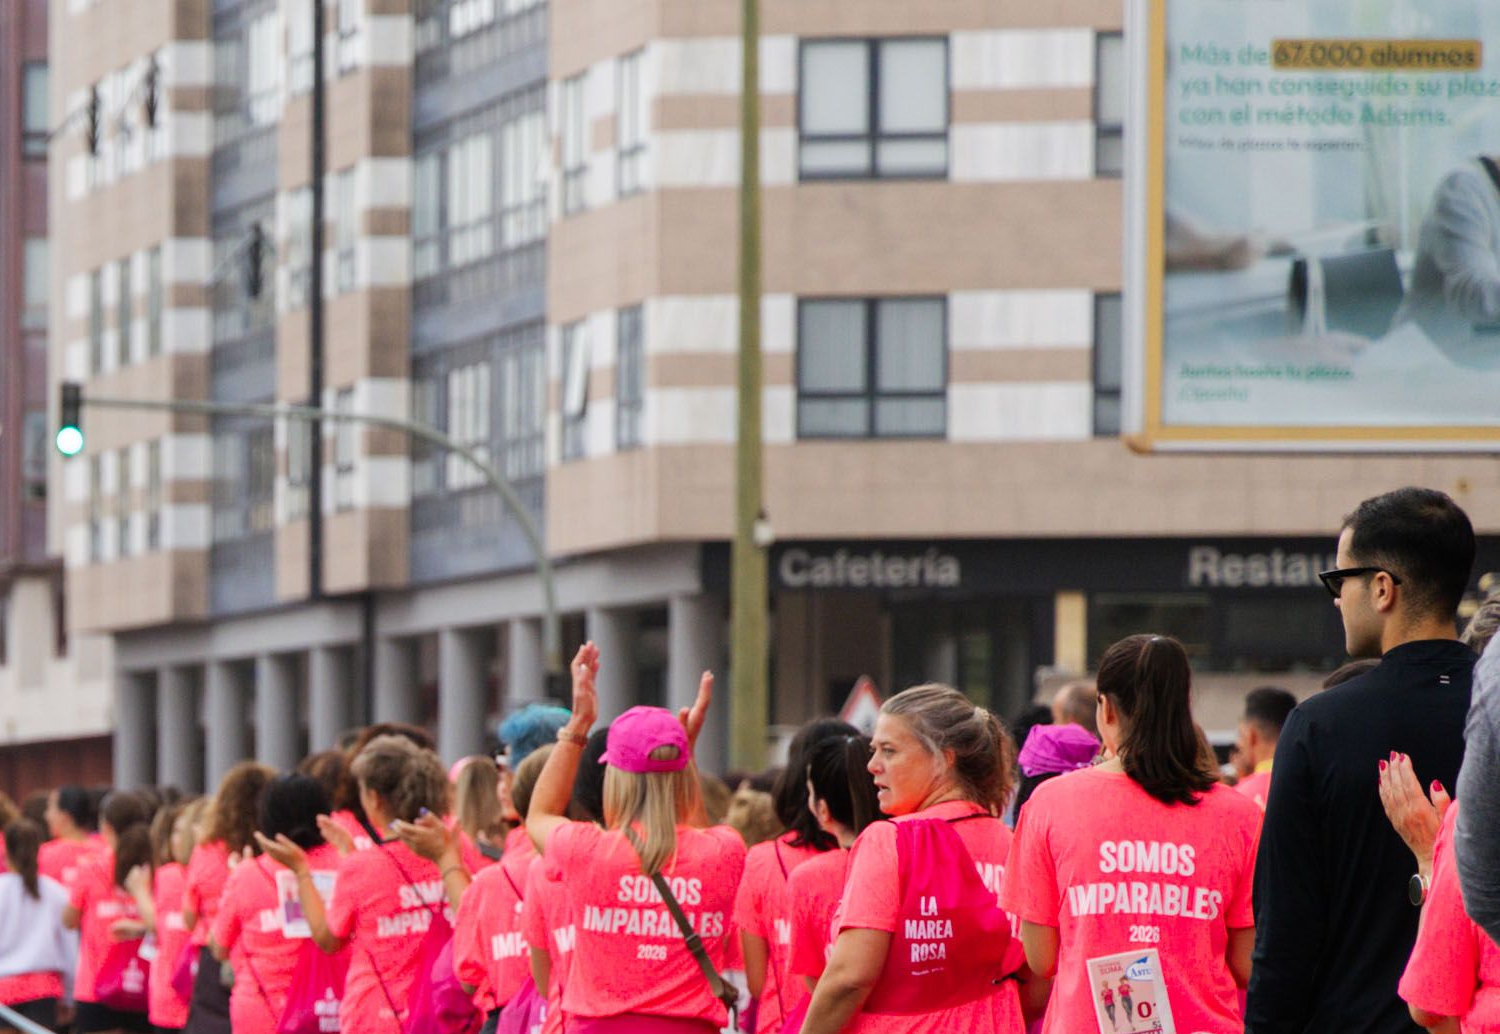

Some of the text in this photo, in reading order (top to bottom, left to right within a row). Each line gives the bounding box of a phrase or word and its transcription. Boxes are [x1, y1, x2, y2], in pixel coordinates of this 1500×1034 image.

[1180, 41, 1475, 66] Más de 67.000 alumnos
[1179, 72, 1500, 101] ya han conseguido su plaz
[1178, 107, 1224, 125] con
[1229, 102, 1249, 126] el
[1256, 102, 1354, 126] método
[779, 547, 961, 587] Cafetería
[1099, 840, 1196, 876] SOMOS
[920, 896, 938, 916] LA
[1068, 881, 1223, 920] IMPARABLES
[905, 919, 953, 939] MAREA
[1129, 925, 1160, 943] 2026
[637, 944, 667, 960] 2026
[911, 942, 946, 963] ROSA
